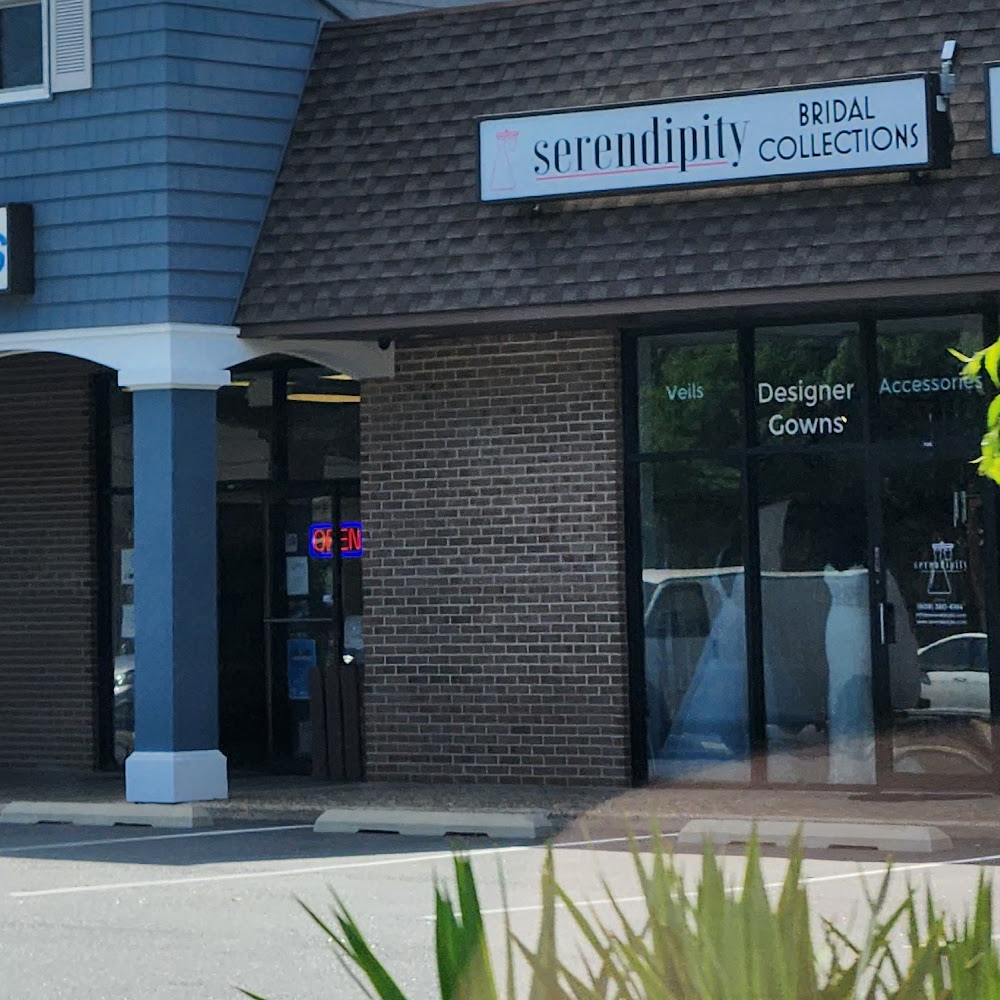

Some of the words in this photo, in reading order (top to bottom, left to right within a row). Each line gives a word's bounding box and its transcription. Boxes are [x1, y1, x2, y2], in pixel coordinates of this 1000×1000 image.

[799, 96, 876, 128] BRIDAL
[533, 113, 751, 175] serendipity
[758, 123, 919, 162] COLLECTIONS
[665, 383, 704, 401] Veils
[757, 380, 855, 407] Designer
[768, 413, 844, 437] Gowns
